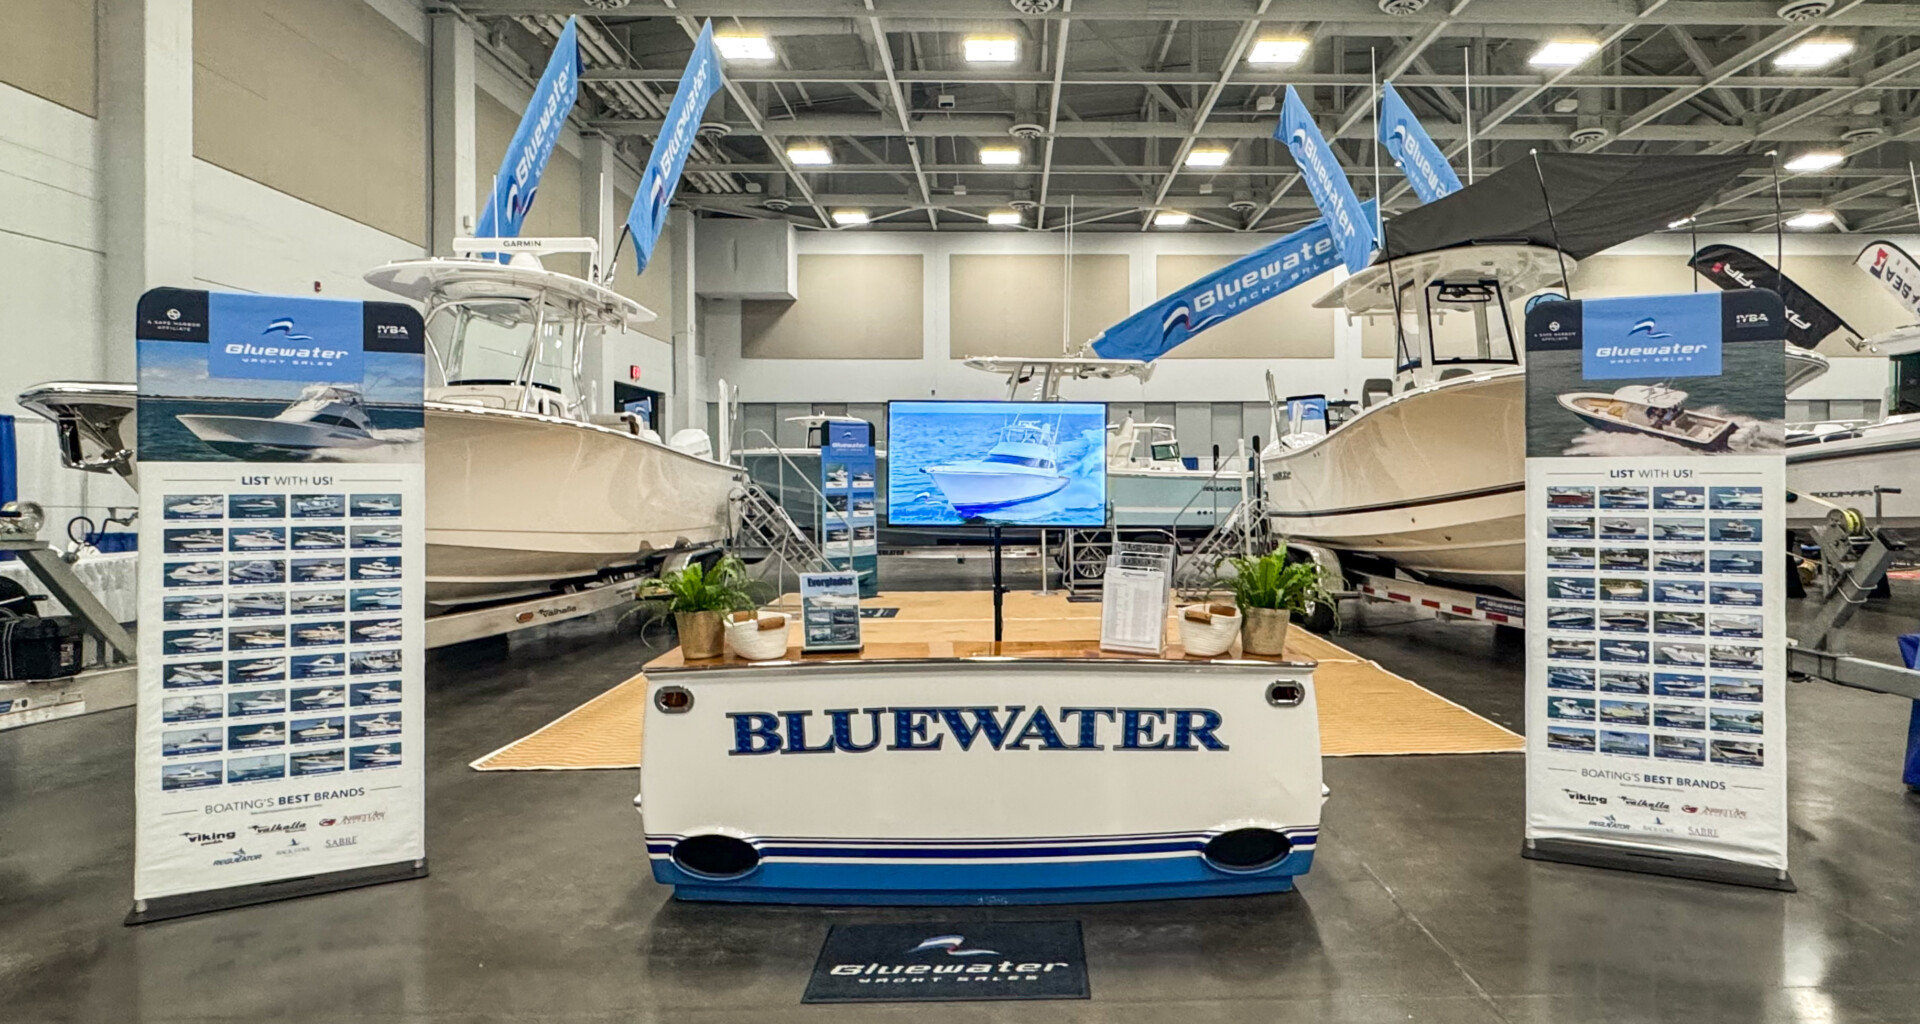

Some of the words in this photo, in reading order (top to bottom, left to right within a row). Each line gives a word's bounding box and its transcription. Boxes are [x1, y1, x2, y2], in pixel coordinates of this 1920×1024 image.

[515, 63, 571, 189] Bluewater
[660, 58, 708, 180] Bluewater
[1405, 134, 1450, 199] Bluewa
[1304, 136, 1356, 237] Bluewater
[502, 240, 542, 248] GARMIN
[1193, 237, 1332, 313] Bluewate
[1228, 280, 1281, 310] YACHT
[377, 325, 408, 335] IYBA
[225, 343, 349, 359] Bluewater
[1596, 343, 1708, 357] Bluewater
[241, 475, 271, 486] LIST
[274, 475, 308, 486] WITH
[312, 475, 333, 486] US!
[1610, 469, 1635, 478] LIST
[1638, 469, 1669, 478] WITH
[1673, 469, 1693, 478] US!
[807, 577, 854, 588] Everglades
[725, 705, 1230, 756] BLUEWATER
[1581, 768, 1640, 782] BOATING'S
[1644, 774, 1673, 785] BEST
[1676, 778, 1726, 790] BRANDS
[205, 798, 275, 815] BOATING'S
[278, 793, 310, 806] BEST
[314, 787, 365, 801] BRANDS
[1568, 793, 1608, 805] viking
[188, 831, 236, 843] viking
[1688, 826, 1720, 838] SABRE
[325, 836, 357, 848] SABRE
[829, 960, 1070, 976] Bluewater
